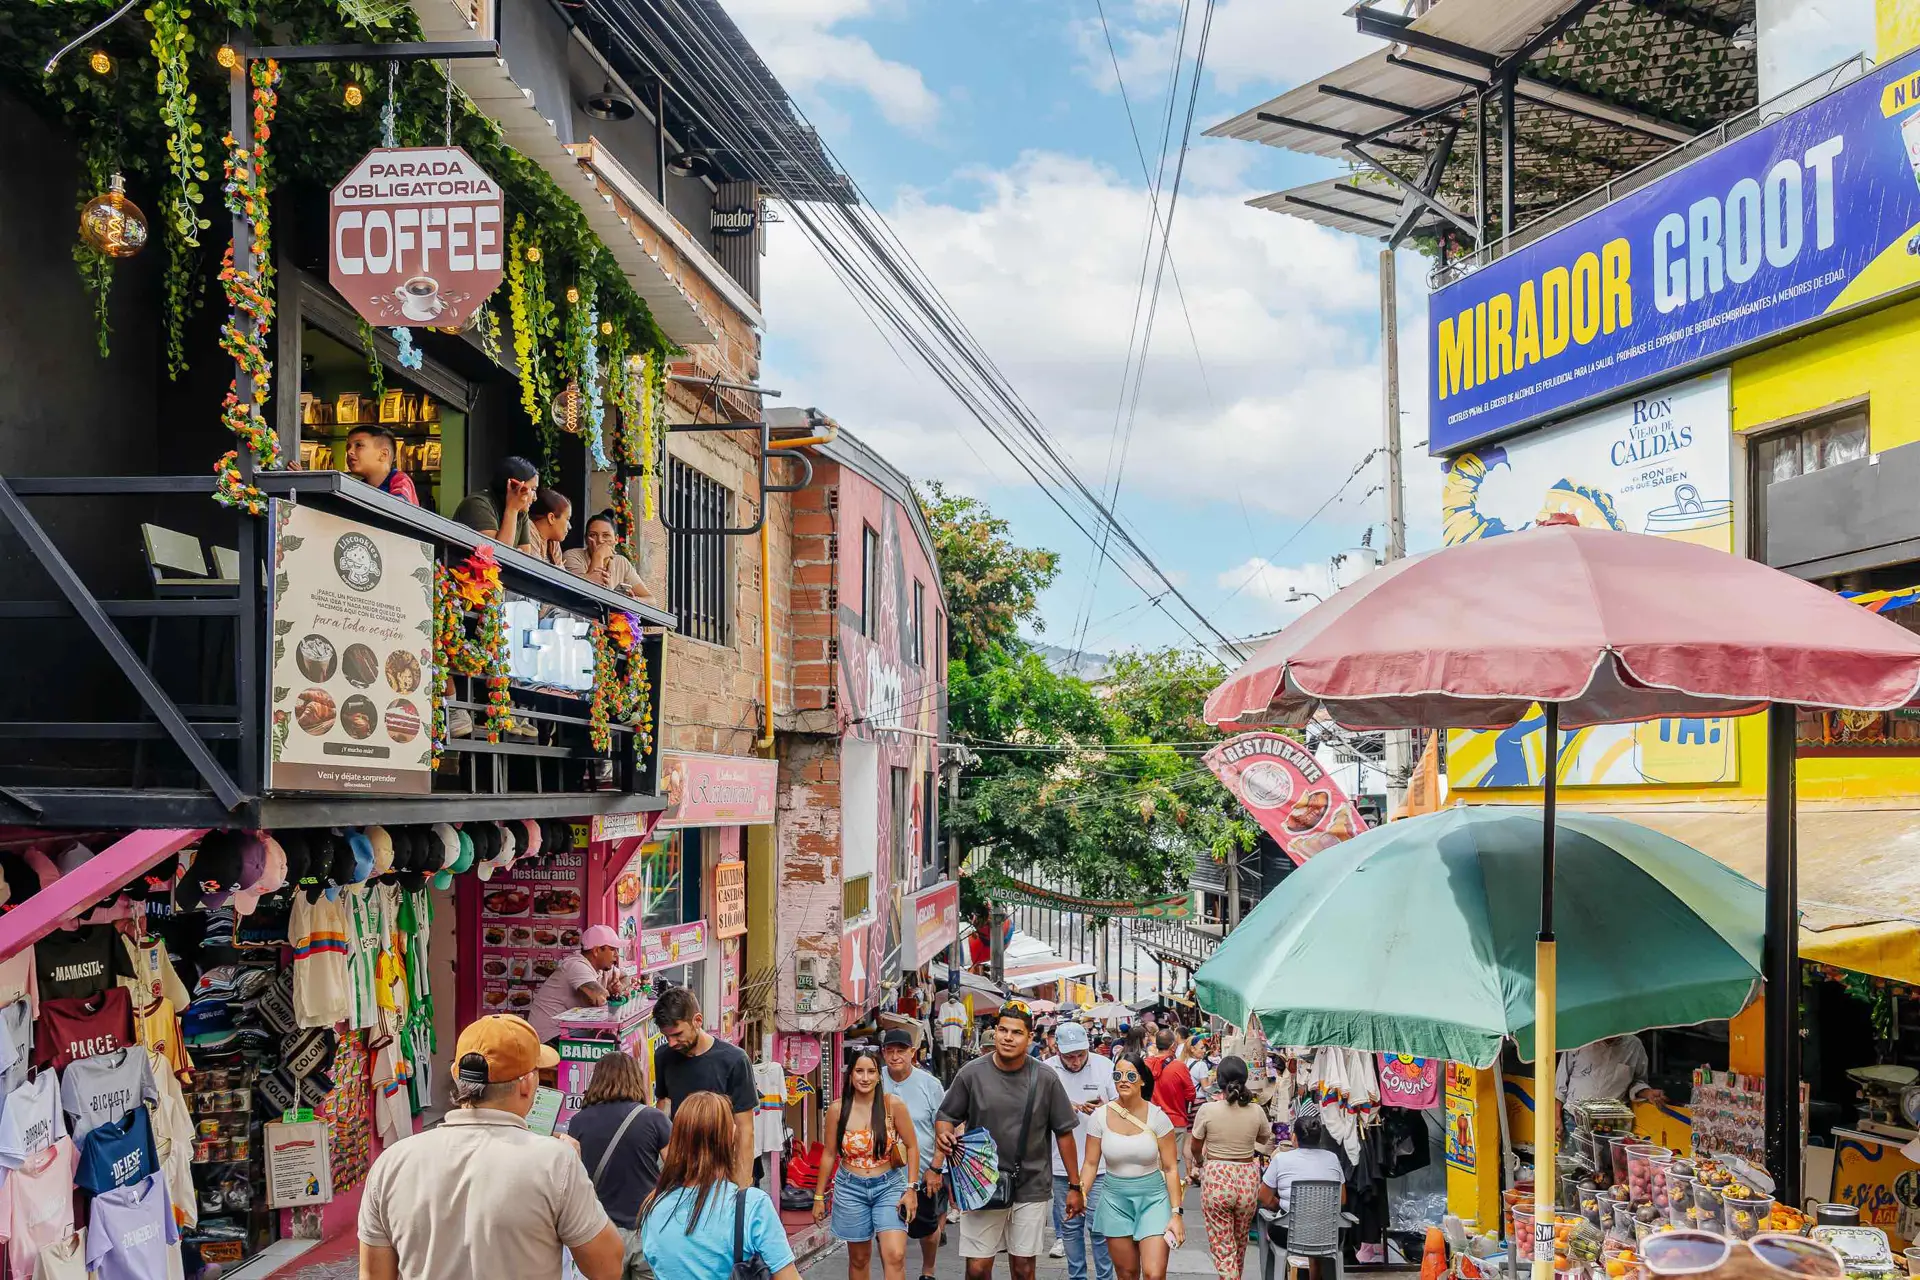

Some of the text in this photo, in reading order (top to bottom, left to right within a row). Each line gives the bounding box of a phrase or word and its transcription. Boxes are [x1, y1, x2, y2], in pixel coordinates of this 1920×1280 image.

[370, 161, 463, 178] PARADA
[342, 179, 492, 199] OBLIGATORIA
[335, 205, 501, 275] COFFEE
[1438, 135, 1843, 400] MIRADOR GROOT
[1490, 397, 1507, 410] EXCESO
[1507, 394, 1514, 402] DE
[1514, 387, 1535, 400] ALCOHOL
[1535, 384, 1542, 393] ES
[1542, 375, 1574, 392] PERJUDICIAL
[1574, 369, 1588, 381] PARA
[1588, 365, 1595, 375] LA
[1648, 341, 1655, 351] EL
[1656, 329, 1685, 348] EXPENDIO
[1685, 325, 1694, 337] DE
[1694, 317, 1721, 334] BEBIDAS
[1721, 298, 1771, 325] EMBRIAGANTES
[1771, 295, 1778, 304] A
[1778, 281, 1812, 302] MENORES
[1813, 277, 1824, 289] DE
[1824, 269, 1846, 286] EDAD.
[1610, 426, 1693, 467] CALDAS
[1620, 471, 1687, 494] LOS QUE SABEN
[1641, 468, 1664, 482] RON
[313, 614, 341, 629] para
[1223, 736, 1325, 784] RESTAURANTE
[362, 774, 396, 783] sorprender
[512, 869, 576, 881] Restaurante
[718, 887, 744, 903] CASEROS
[992, 887, 1032, 902] MEXICAN
[1033, 896, 1054, 908] AND
[1057, 901, 1111, 915] VEGETARIAN
[718, 911, 745, 929] $10.000
[561, 1044, 612, 1059] BAÑOS
